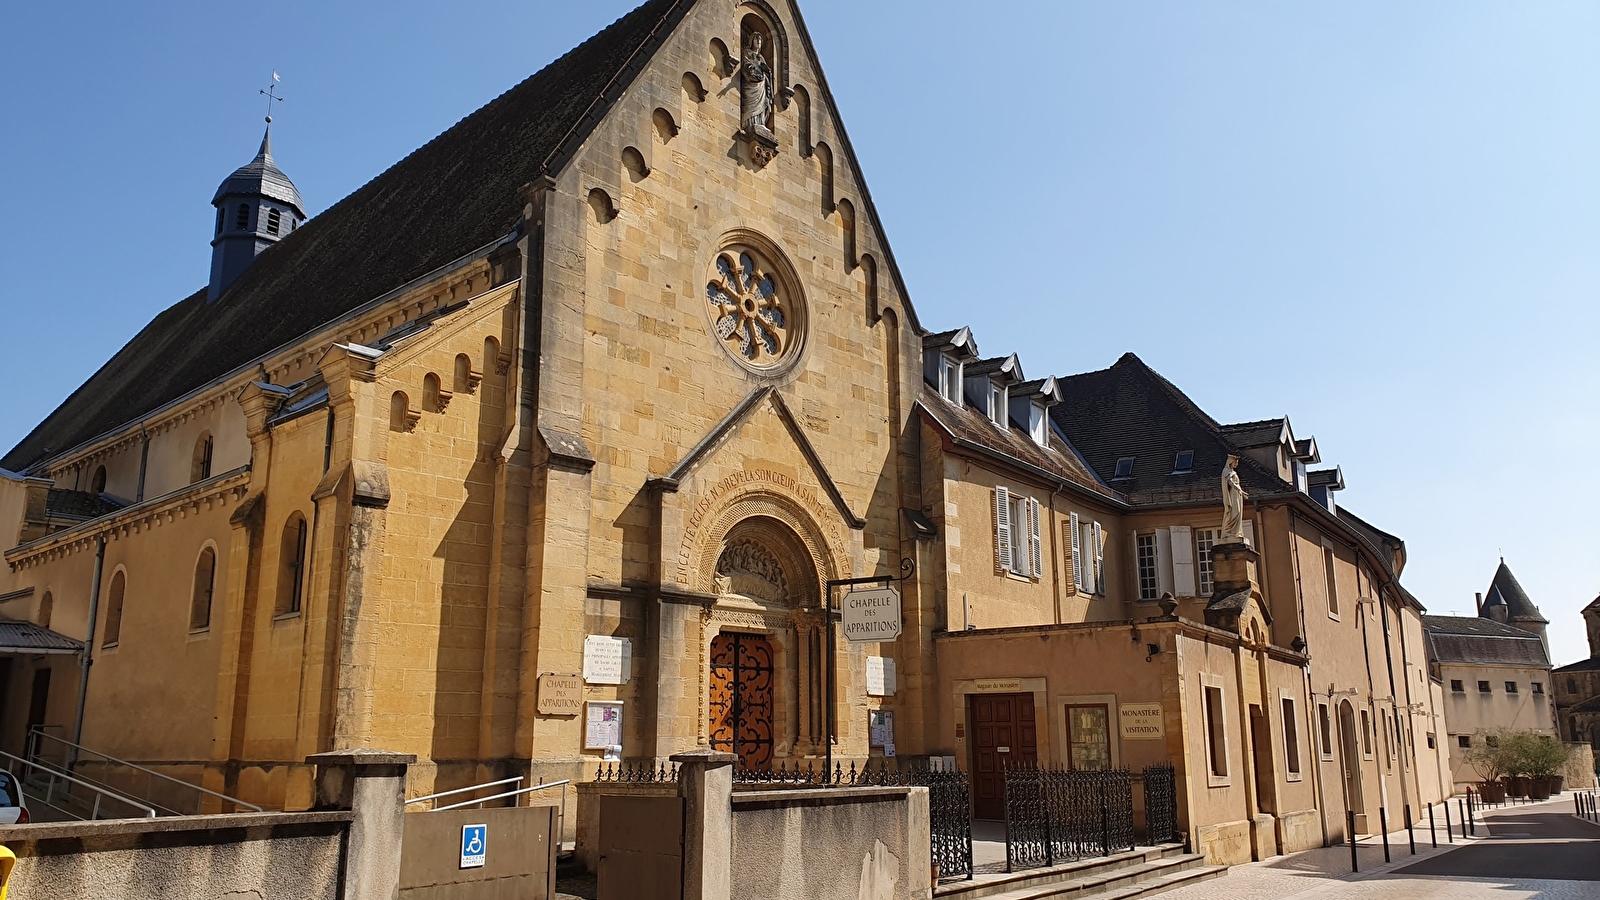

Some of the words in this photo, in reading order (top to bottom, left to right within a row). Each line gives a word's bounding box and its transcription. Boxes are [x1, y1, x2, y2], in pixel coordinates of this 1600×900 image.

[724, 469, 756, 491] REVELA
[754, 469, 772, 482] SON
[800, 488, 826, 517] SAINTE
[689, 496, 714, 530] EGLISE
[678, 526, 696, 565] CETTE
[677, 567, 689, 585] EN
[849, 597, 891, 609] CHAPELLE
[864, 609, 876, 617] DES
[846, 620, 897, 633] APPARITIONS
[546, 680, 578, 689] CHAPELLE
[541, 698, 581, 708] APPARITIONS
[1122, 708, 1160, 717] MONASTÈRE
